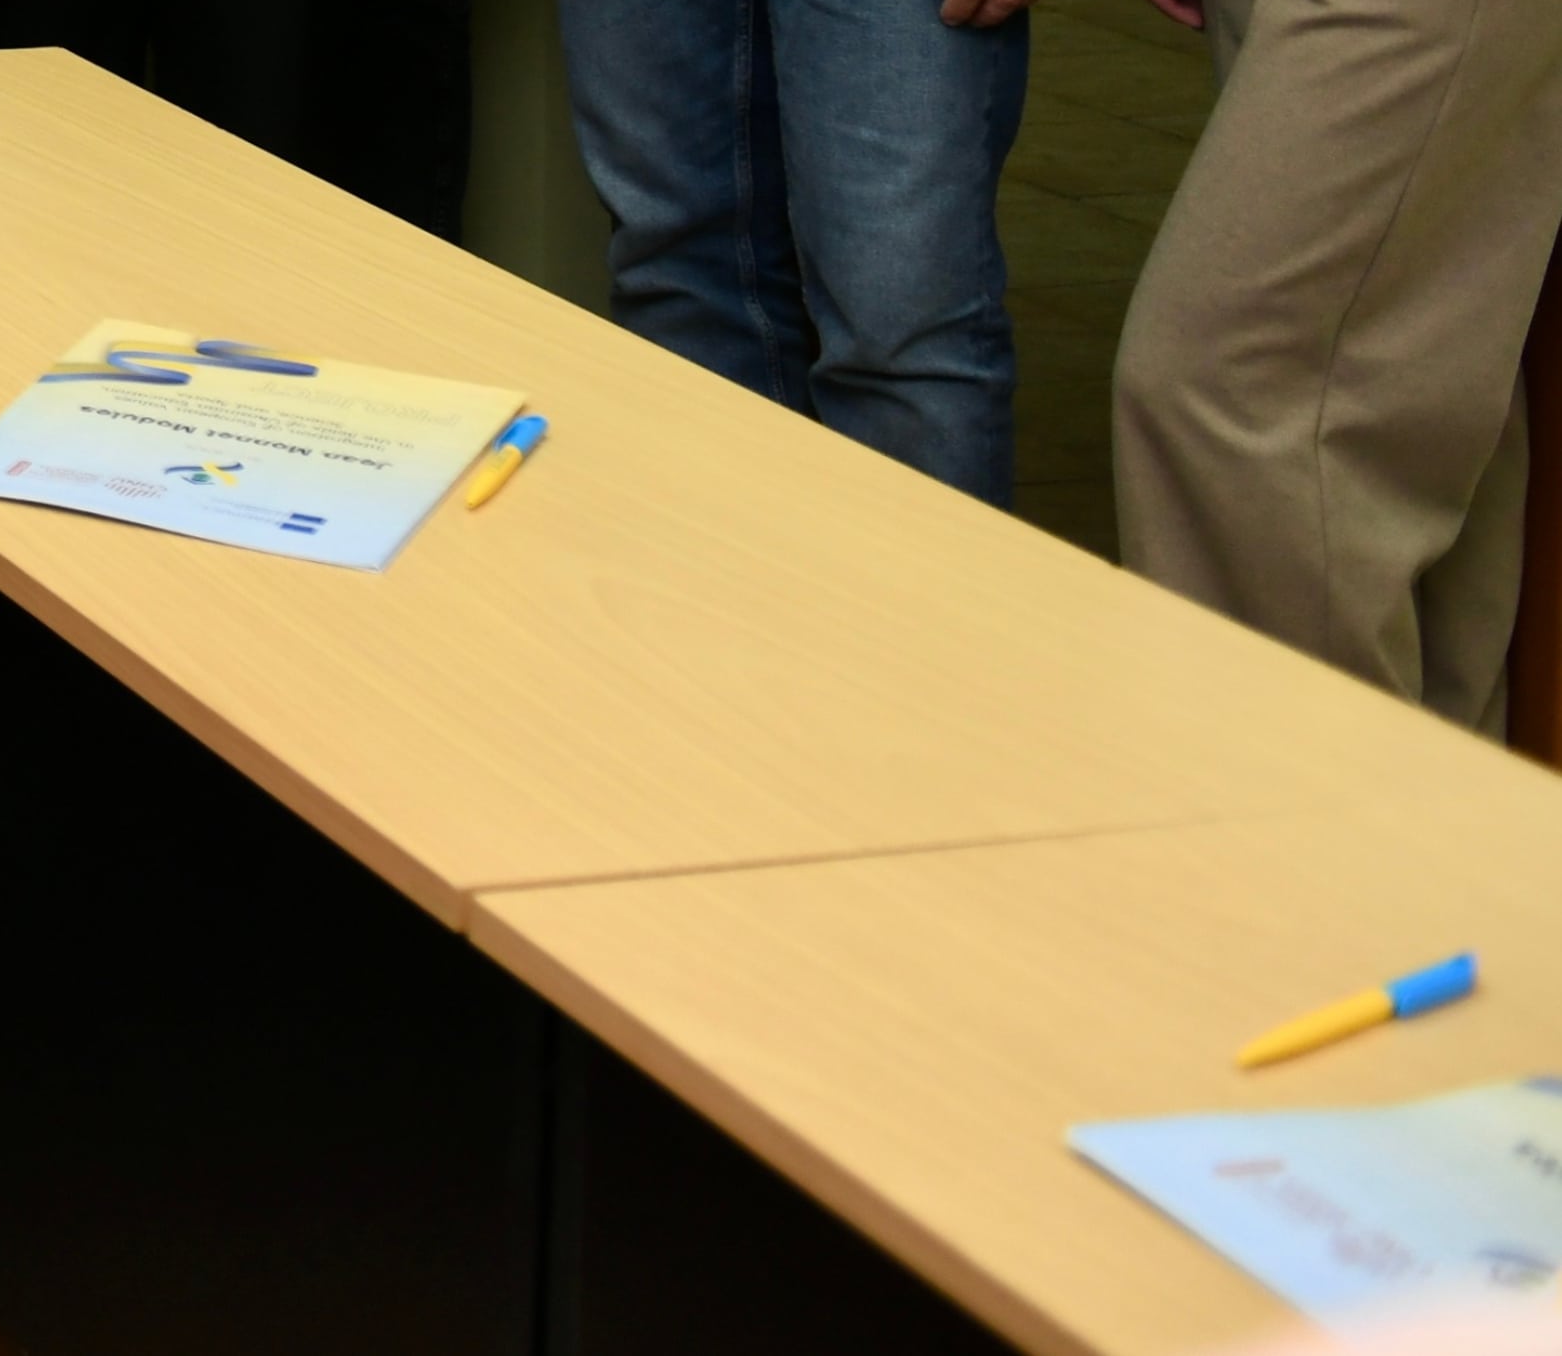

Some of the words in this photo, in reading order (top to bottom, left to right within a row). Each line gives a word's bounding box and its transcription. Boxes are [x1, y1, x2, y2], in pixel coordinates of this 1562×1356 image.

[73, 404, 200, 434] Modules
[200, 428, 315, 456] Monnet
[317, 450, 394, 471] Jean
